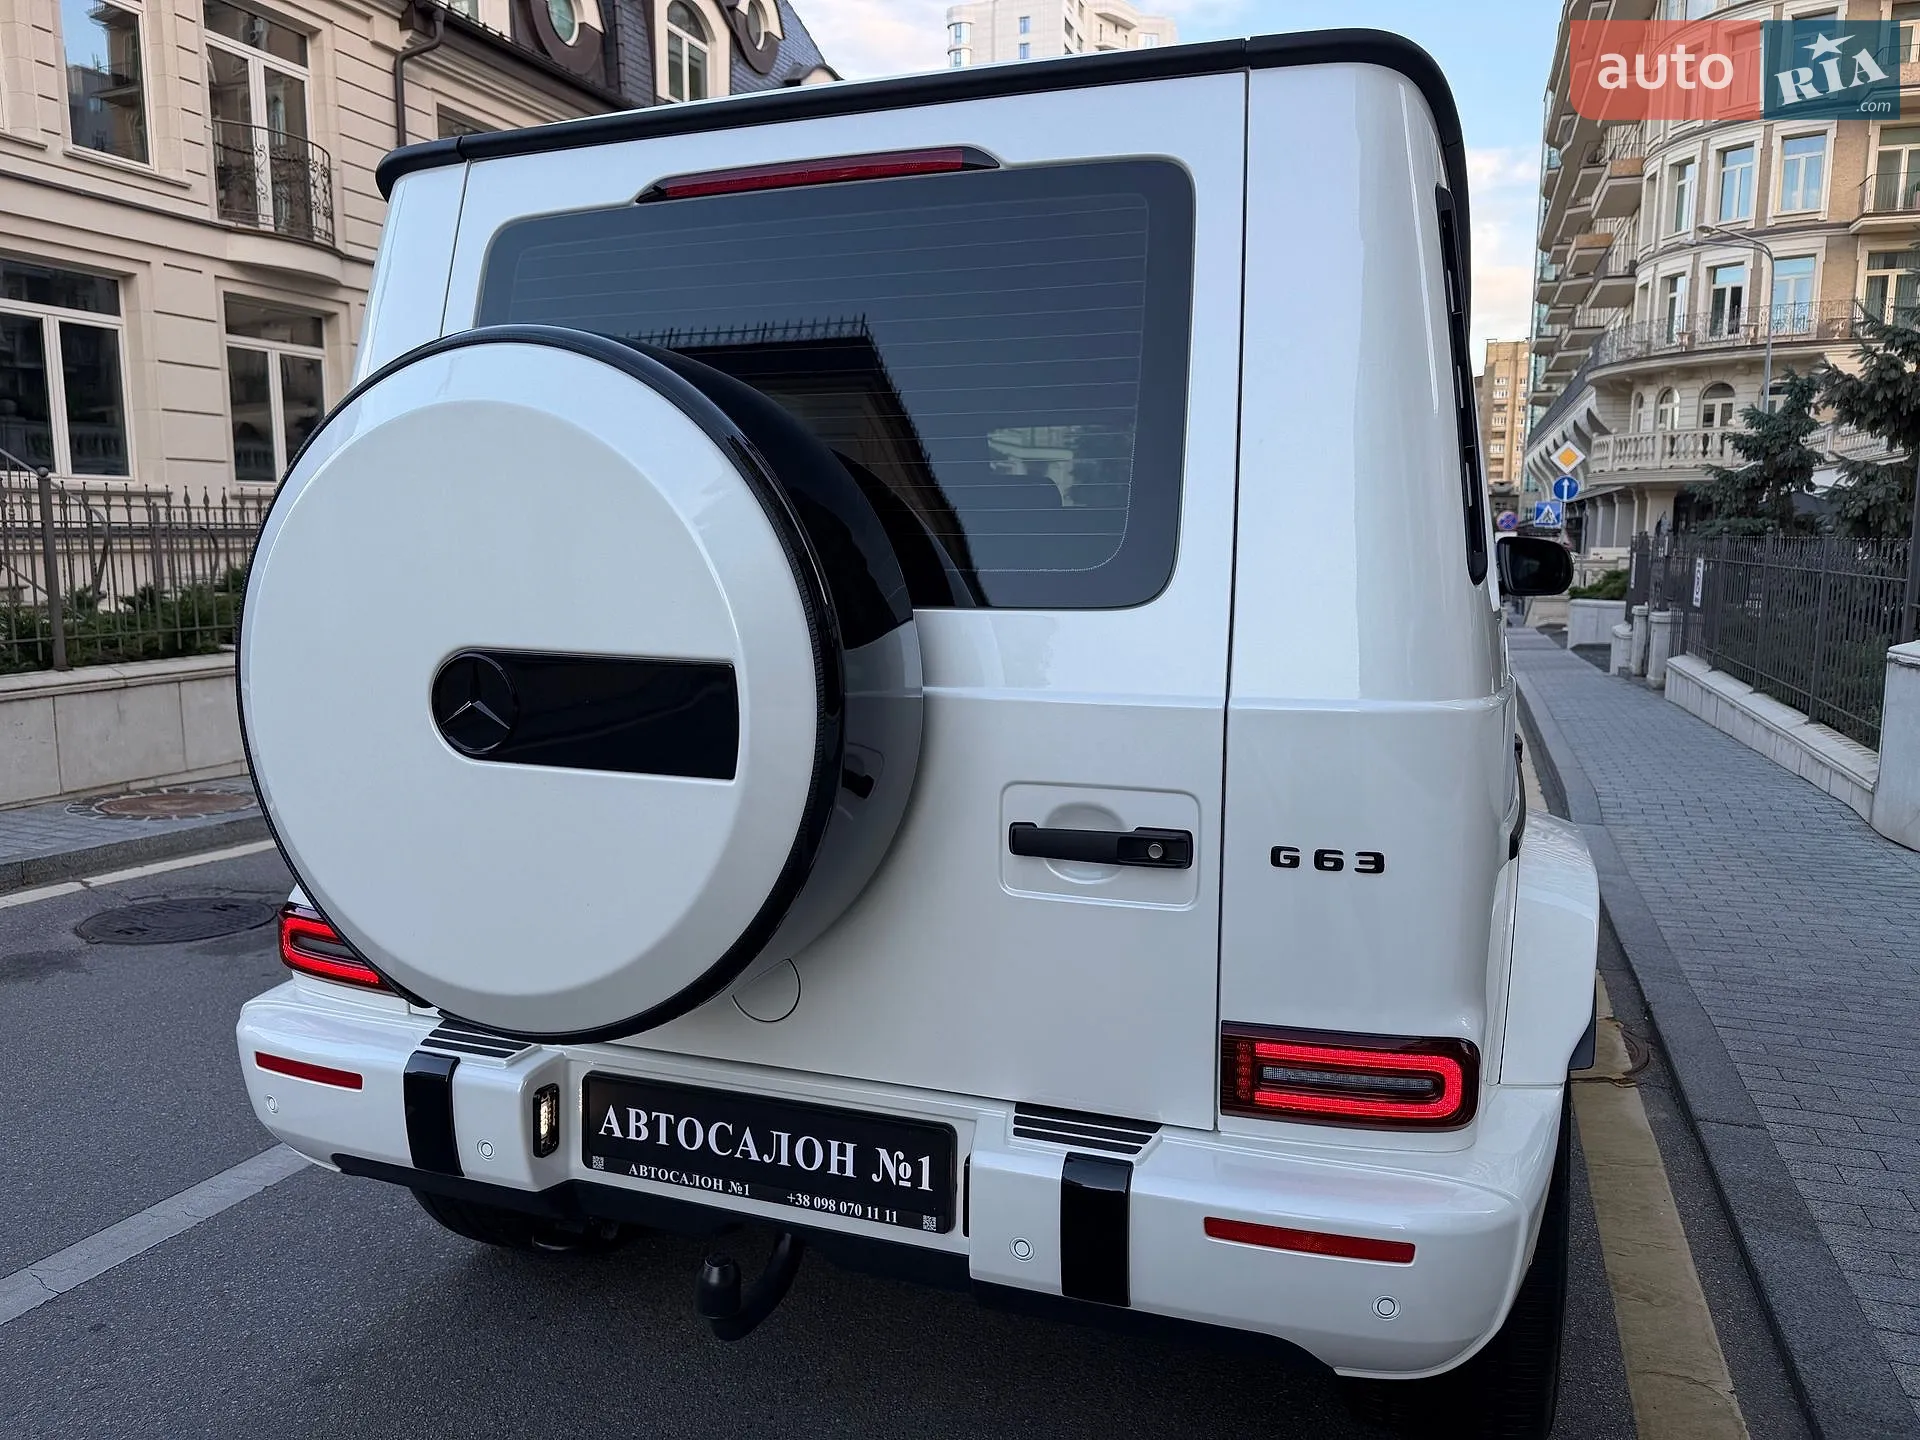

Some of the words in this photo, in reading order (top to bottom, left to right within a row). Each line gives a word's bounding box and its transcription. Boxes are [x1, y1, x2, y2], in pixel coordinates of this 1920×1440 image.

[598, 1104, 858, 1179] АВТОСАЛОН
[871, 1146, 934, 1192] №1
[628, 1163, 723, 1191] АВТОСАЛОН
[728, 1181, 750, 1196] №1
[786, 1192, 810, 1208] +38
[813, 1197, 836, 1214] 098
[839, 1202, 862, 1218] 070
[866, 1206, 882, 1222] 11
[884, 1209, 898, 1224] 11
